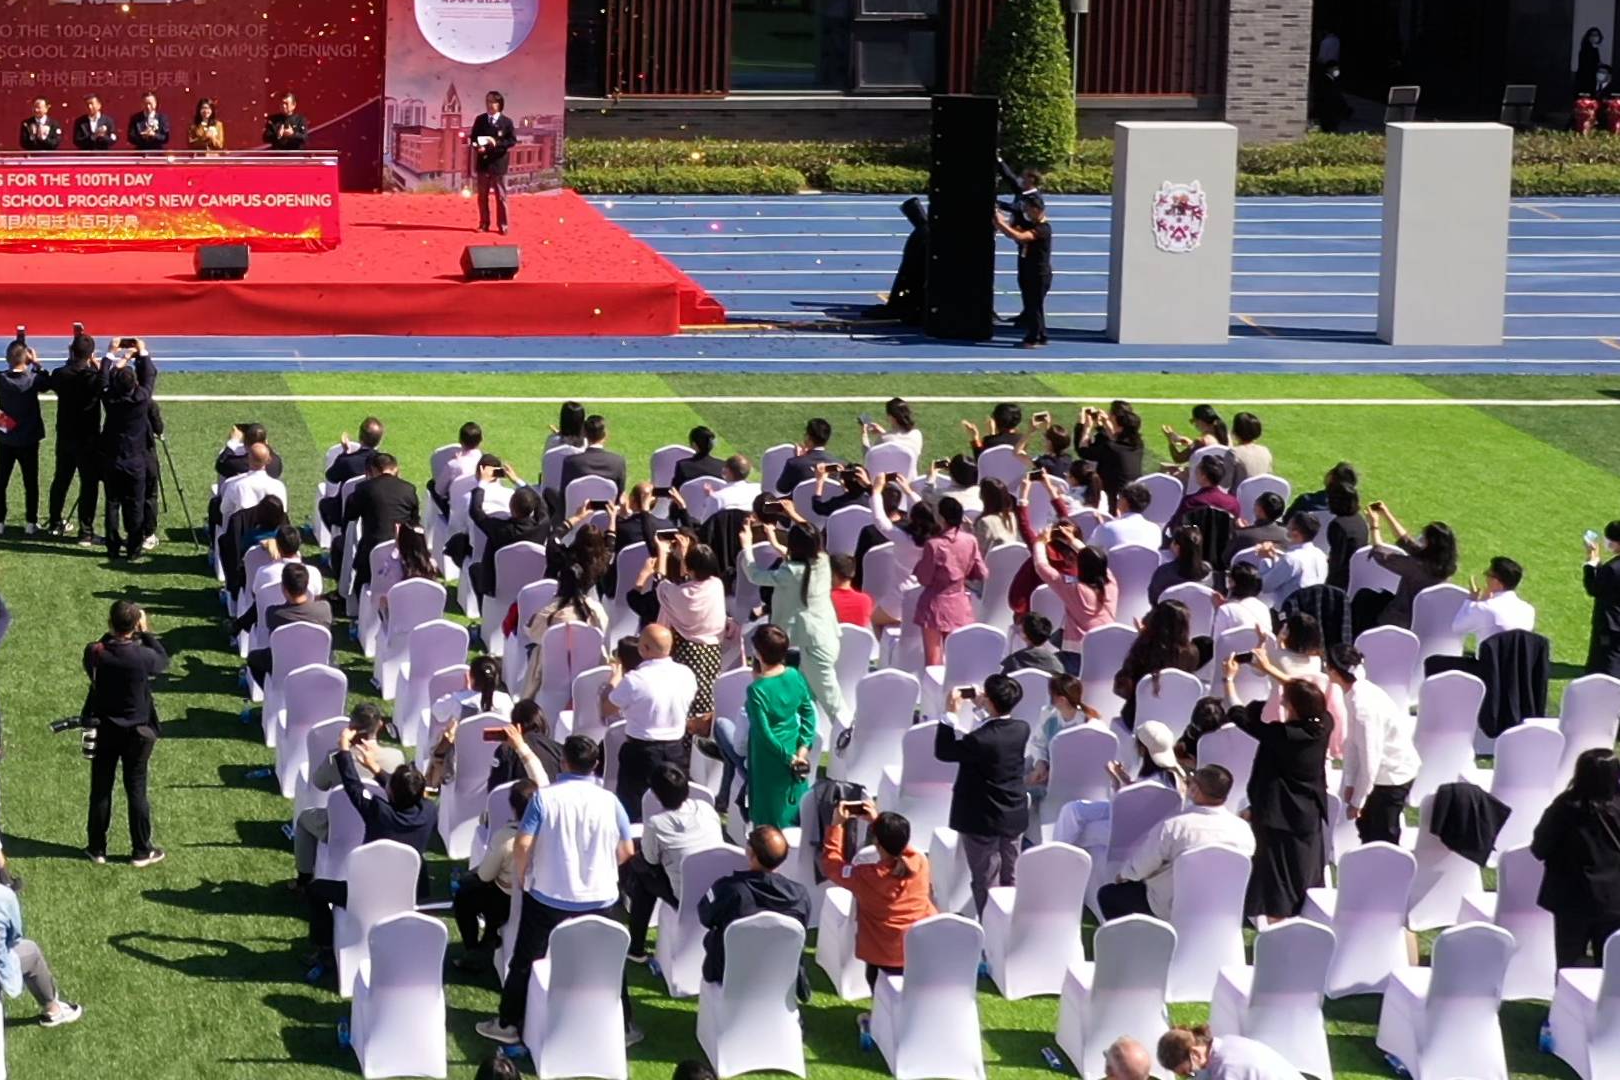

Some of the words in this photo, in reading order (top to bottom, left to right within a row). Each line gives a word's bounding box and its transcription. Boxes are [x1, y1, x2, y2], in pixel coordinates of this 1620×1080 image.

[18, 24, 50, 38] THE
[57, 24, 123, 38] 100-DAY
[127, 24, 243, 38] CELEBRATION
[247, 24, 268, 38] OF
[73, 44, 151, 58] ZHUHAI'S
[155, 44, 194, 58] NEW
[199, 44, 268, 58] CAMPUS
[7, 173, 37, 188] FOR
[41, 173, 70, 188] THE
[76, 173, 120, 188] 100TH
[124, 173, 154, 188] DAY
[2, 194, 64, 208] SCHOOL
[68, 194, 155, 208] PROGRAM'S
[159, 194, 194, 208] NEW
[198, 194, 262, 208] CAMPUS
[266, 194, 332, 208] OPENING
